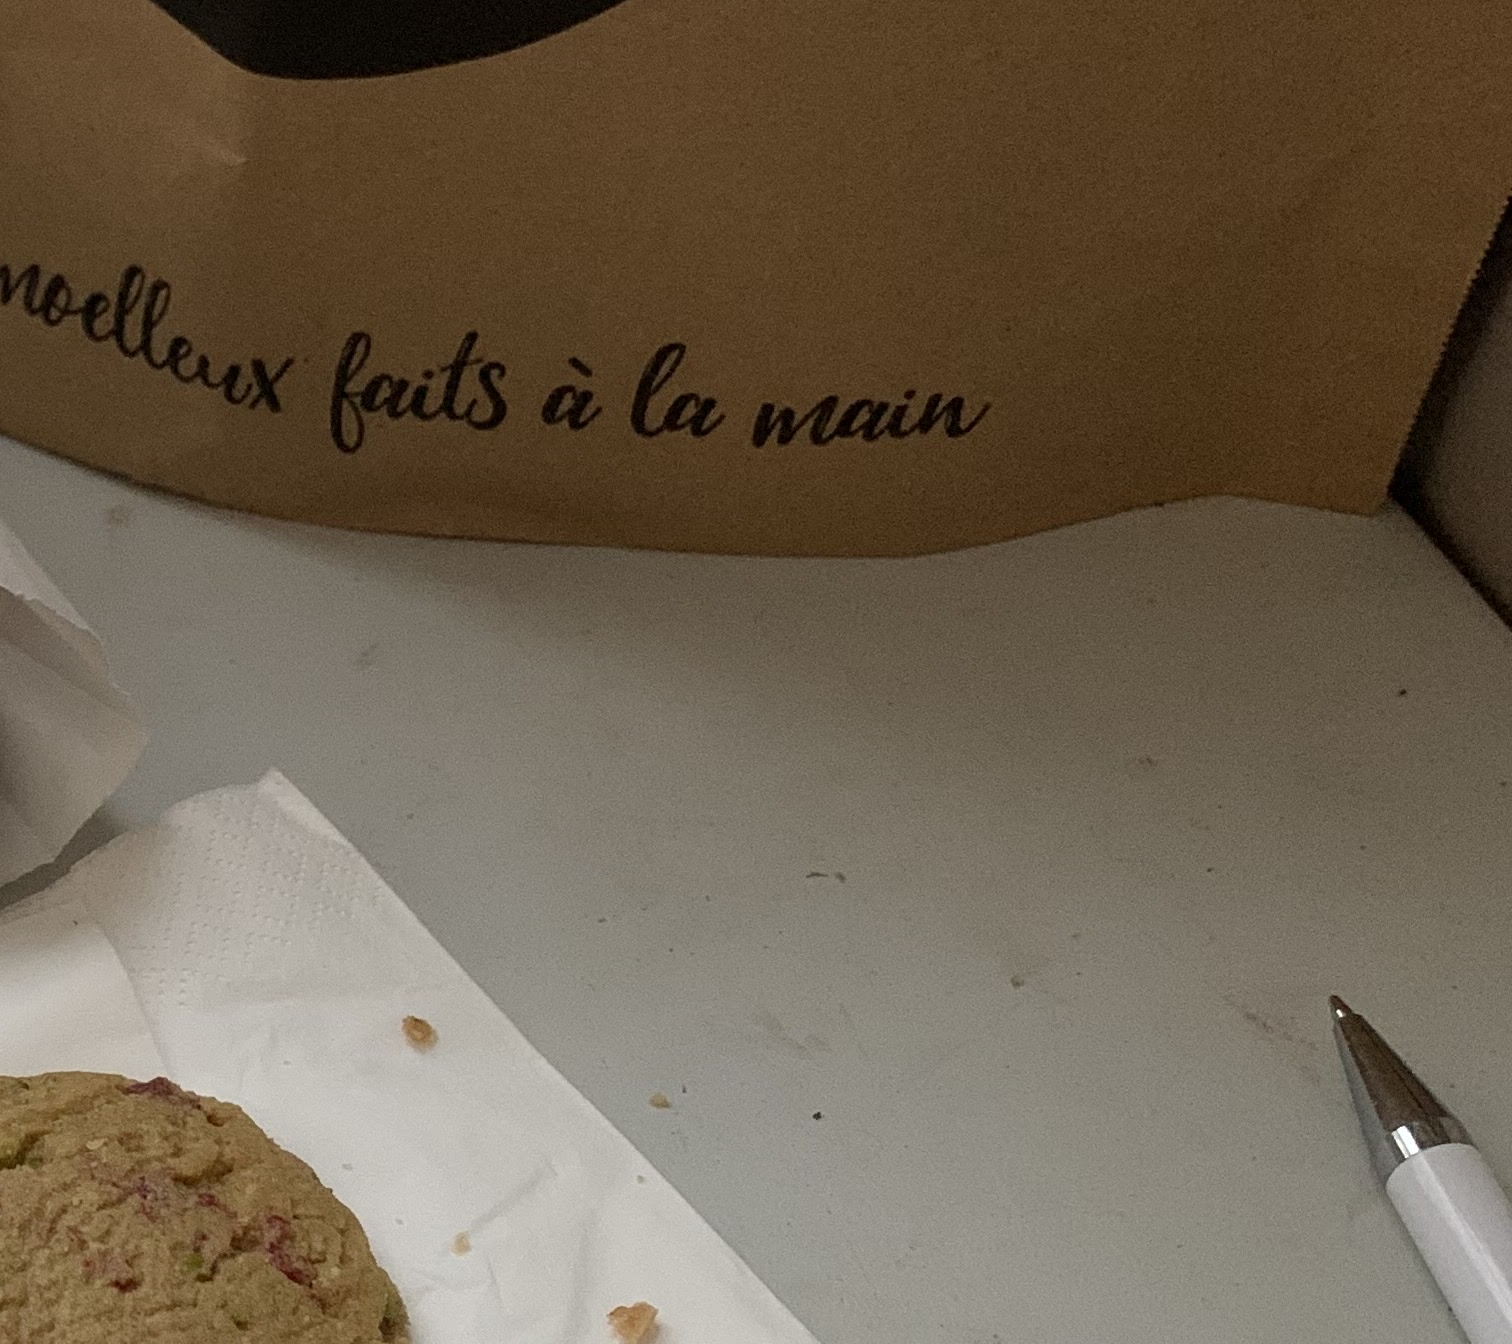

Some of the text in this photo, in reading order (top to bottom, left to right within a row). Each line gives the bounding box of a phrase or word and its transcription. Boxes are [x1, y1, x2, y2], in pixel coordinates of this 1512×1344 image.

[330, 330, 508, 453] faits
[541, 356, 603, 431] à
[629, 342, 727, 439] la
[752, 388, 993, 449] main
